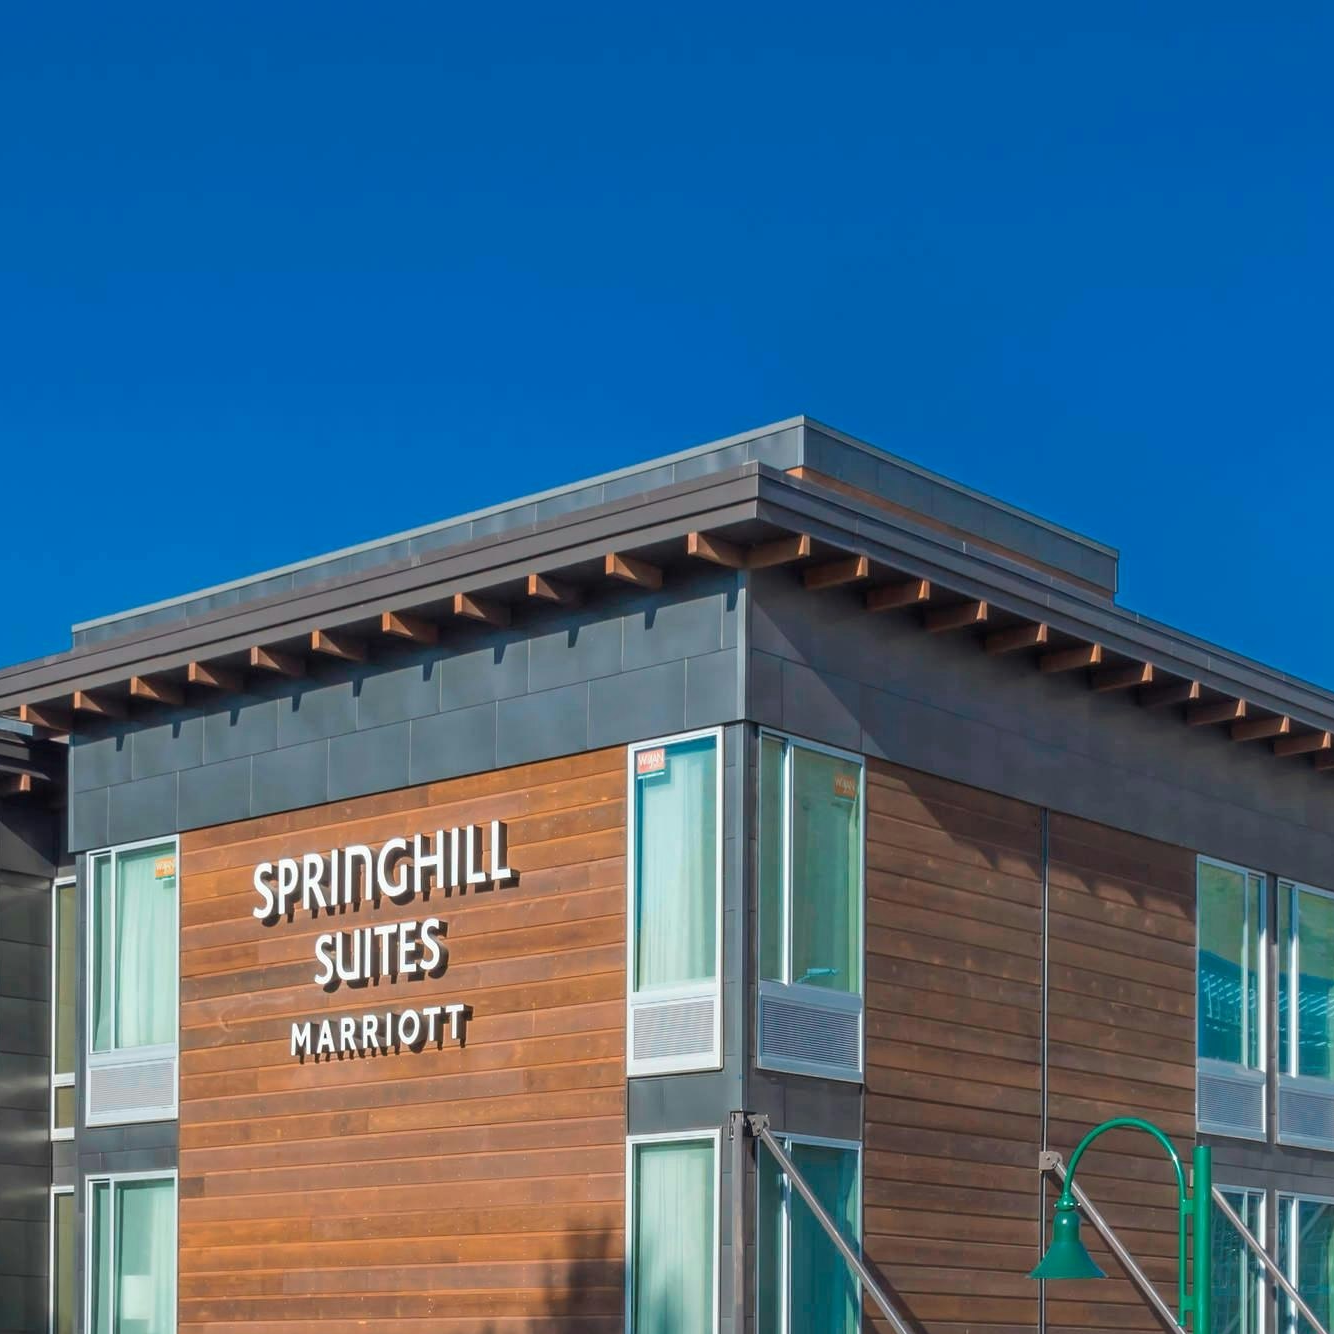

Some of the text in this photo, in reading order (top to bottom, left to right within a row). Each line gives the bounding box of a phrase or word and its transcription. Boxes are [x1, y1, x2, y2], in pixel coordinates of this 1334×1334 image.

[252, 819, 512, 919] SPRINGHILL
[314, 917, 441, 985] SUITES
[290, 1003, 465, 1057] MARRIOTT
